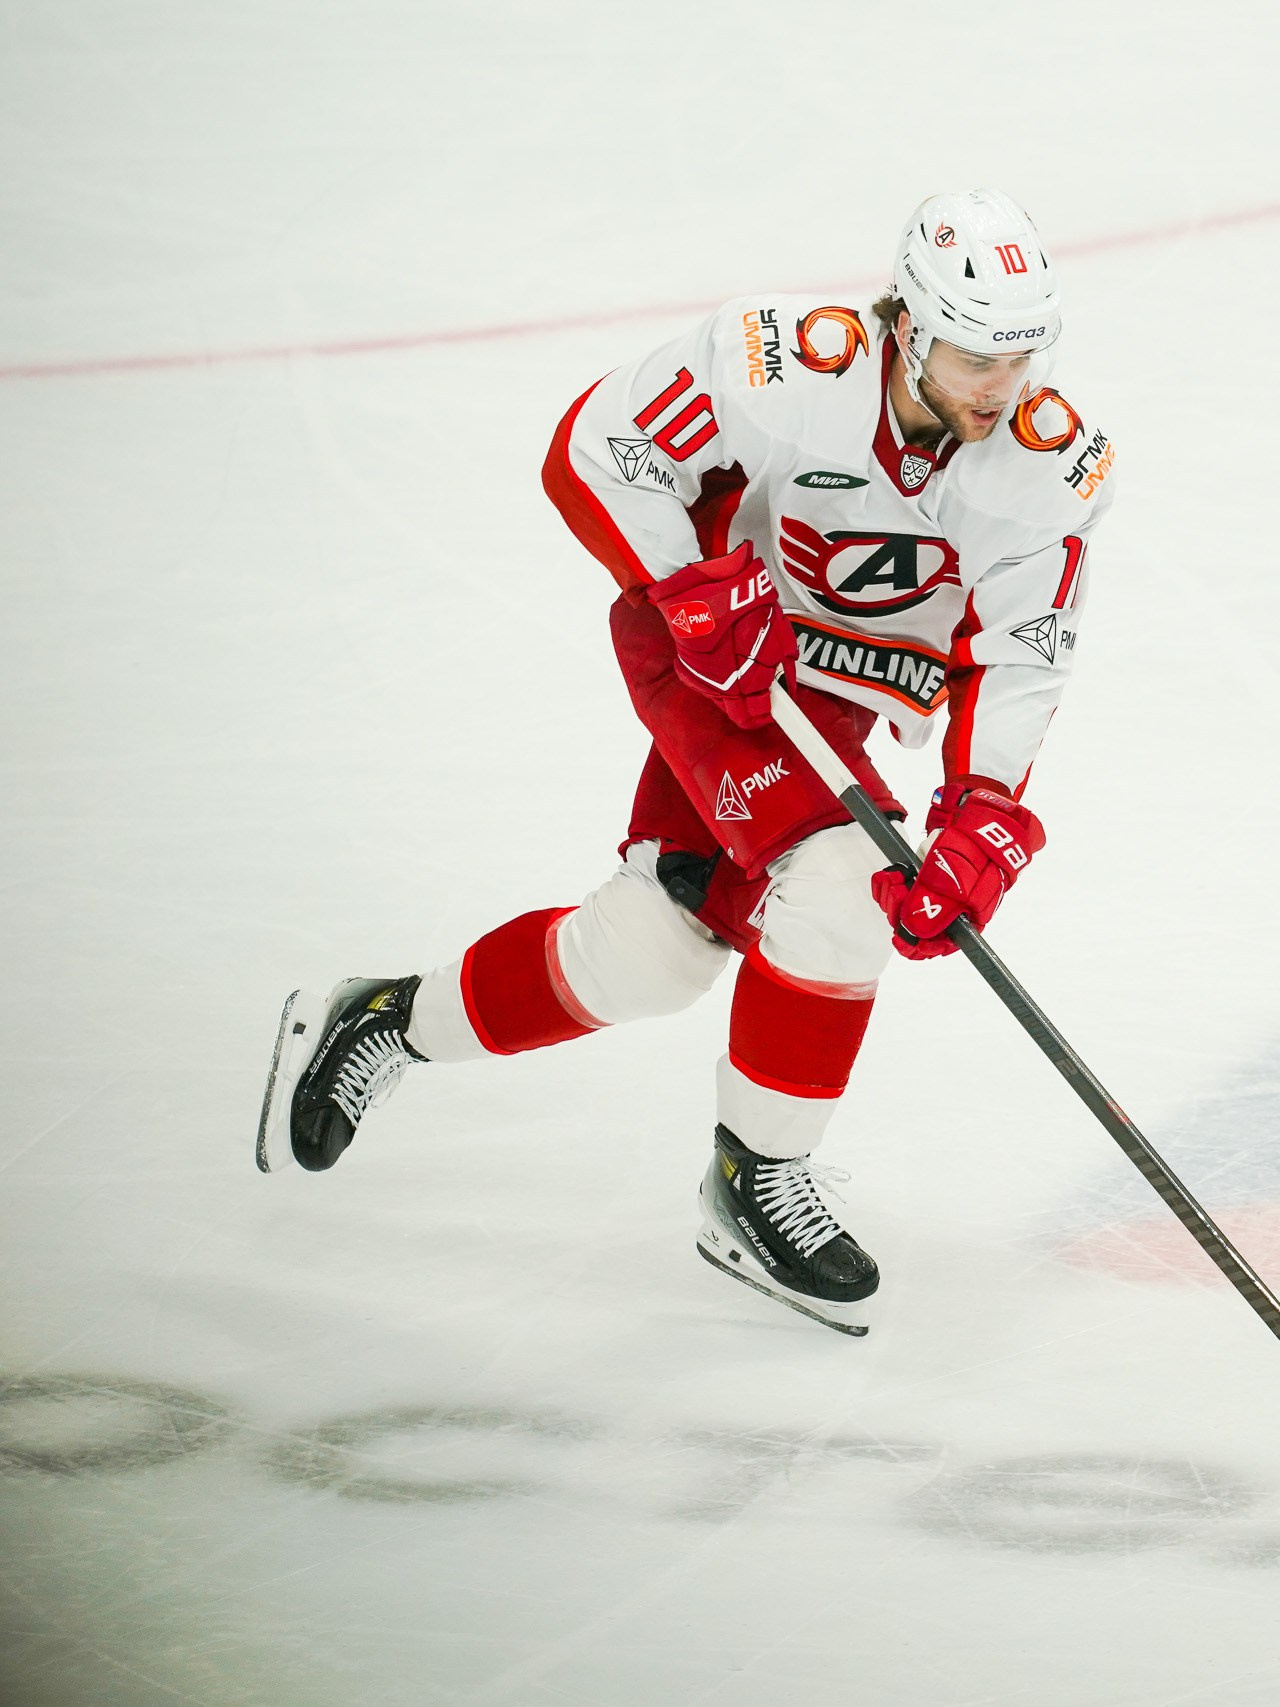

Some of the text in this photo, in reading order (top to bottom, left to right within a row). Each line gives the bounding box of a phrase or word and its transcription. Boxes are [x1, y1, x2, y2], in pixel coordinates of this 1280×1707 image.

[994, 243, 1028, 275] 10
[743, 310, 766, 388] UMMC
[759, 308, 784, 385] УГМК
[632, 366, 720, 463] 10
[645, 460, 676, 493] РМК
[808, 474, 850, 486] МИР
[1063, 427, 1108, 489] УГМК
[1051, 535, 1088, 609] 1
[688, 611, 712, 625] РМК
[1060, 630, 1077, 651] РМ
[796, 632, 946, 701] WINLINE
[740, 758, 791, 799] РМК
